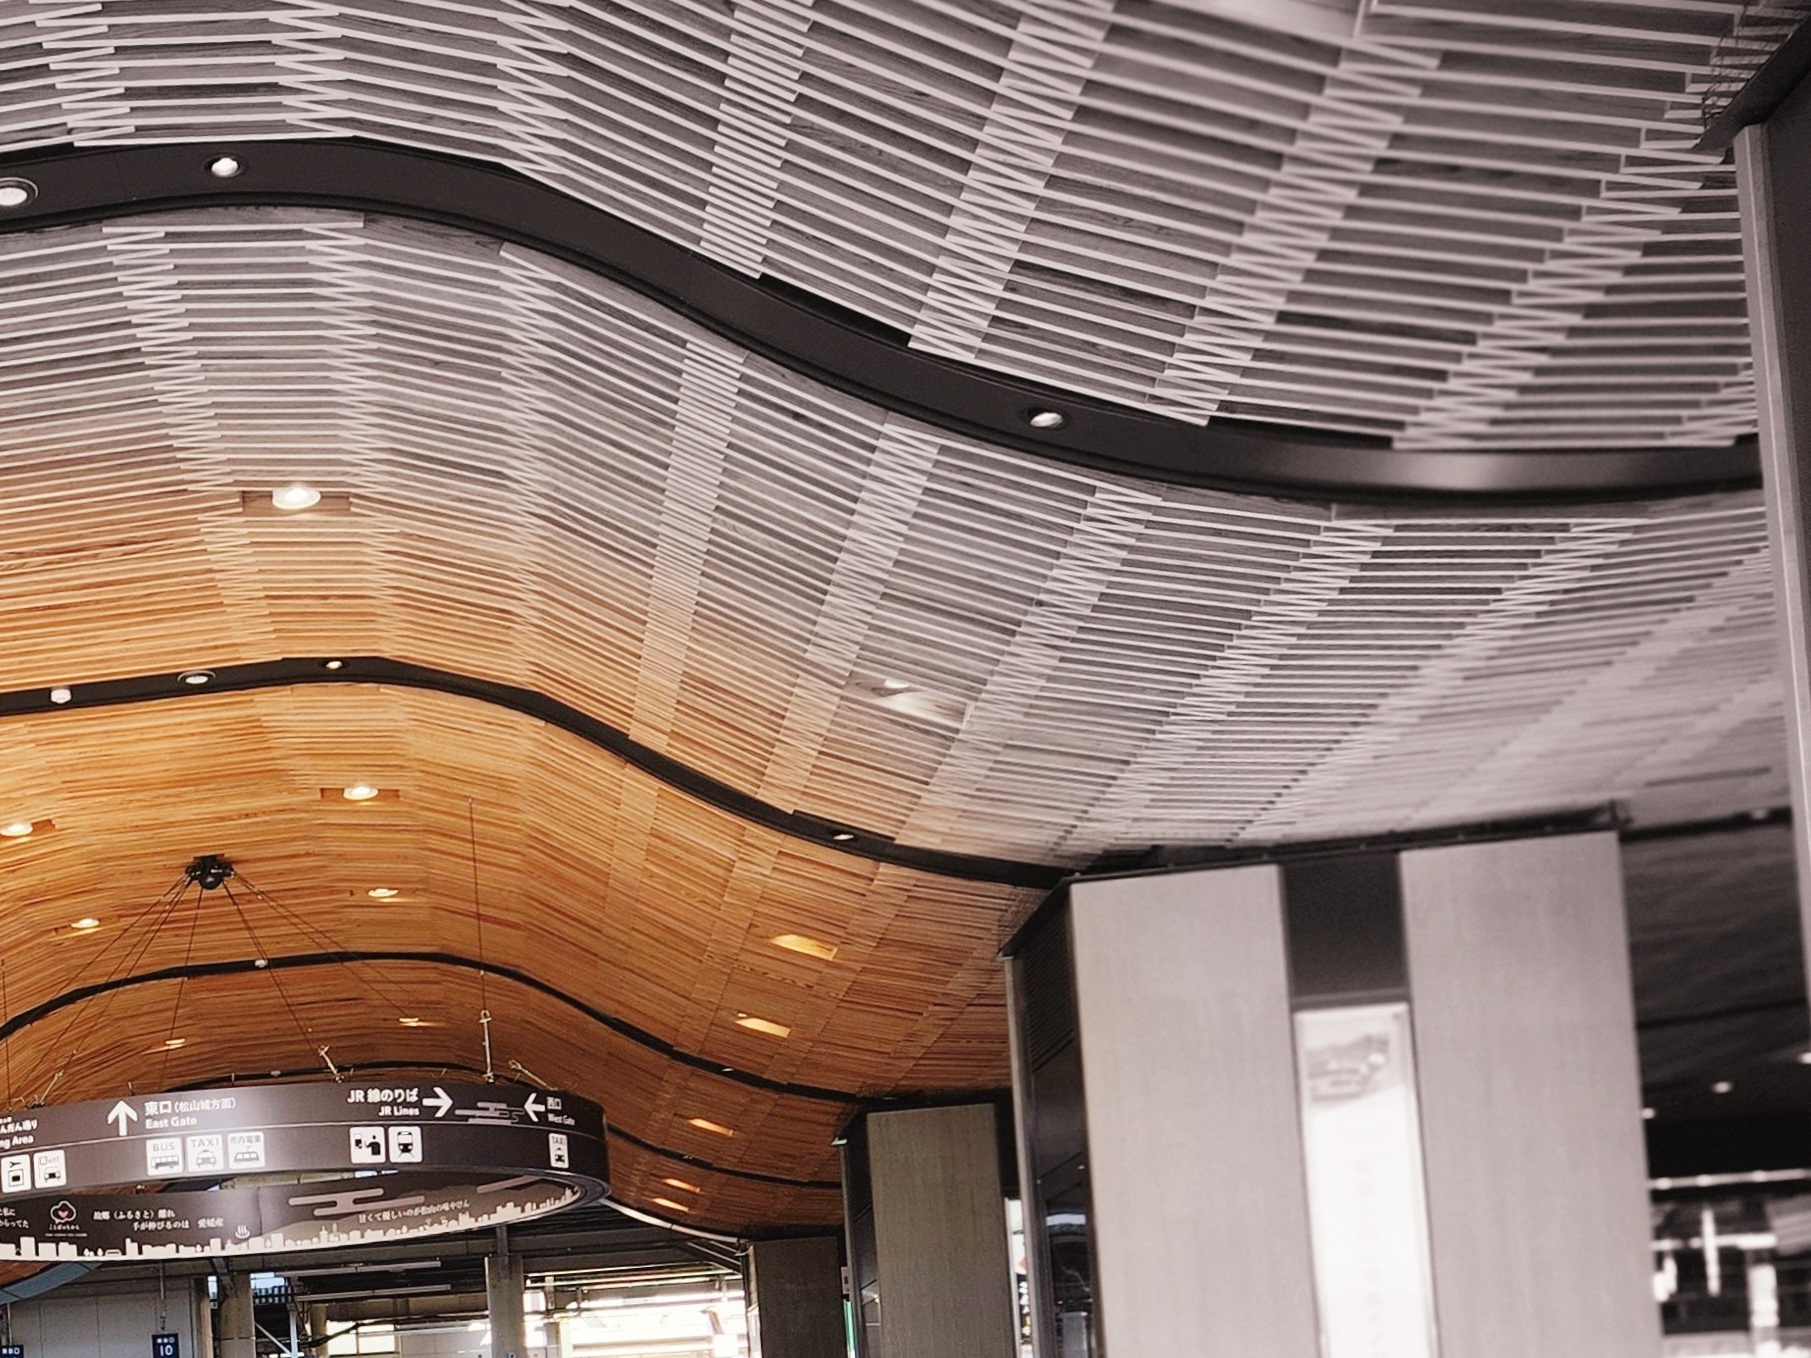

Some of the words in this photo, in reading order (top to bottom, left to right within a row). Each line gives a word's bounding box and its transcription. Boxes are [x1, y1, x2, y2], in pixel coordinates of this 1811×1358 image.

[378, 1106, 391, 1116] JR
[393, 1104, 420, 1116] Lines
[145, 1118, 169, 1130] East
[171, 1116, 197, 1127] Gate
[12, 1135, 34, 1146] Area
[190, 1137, 220, 1148] TAXI
[229, 1135, 261, 1144] 市内電車
[153, 1142, 175, 1152] BUS
[160, 1345, 173, 1357] 10
